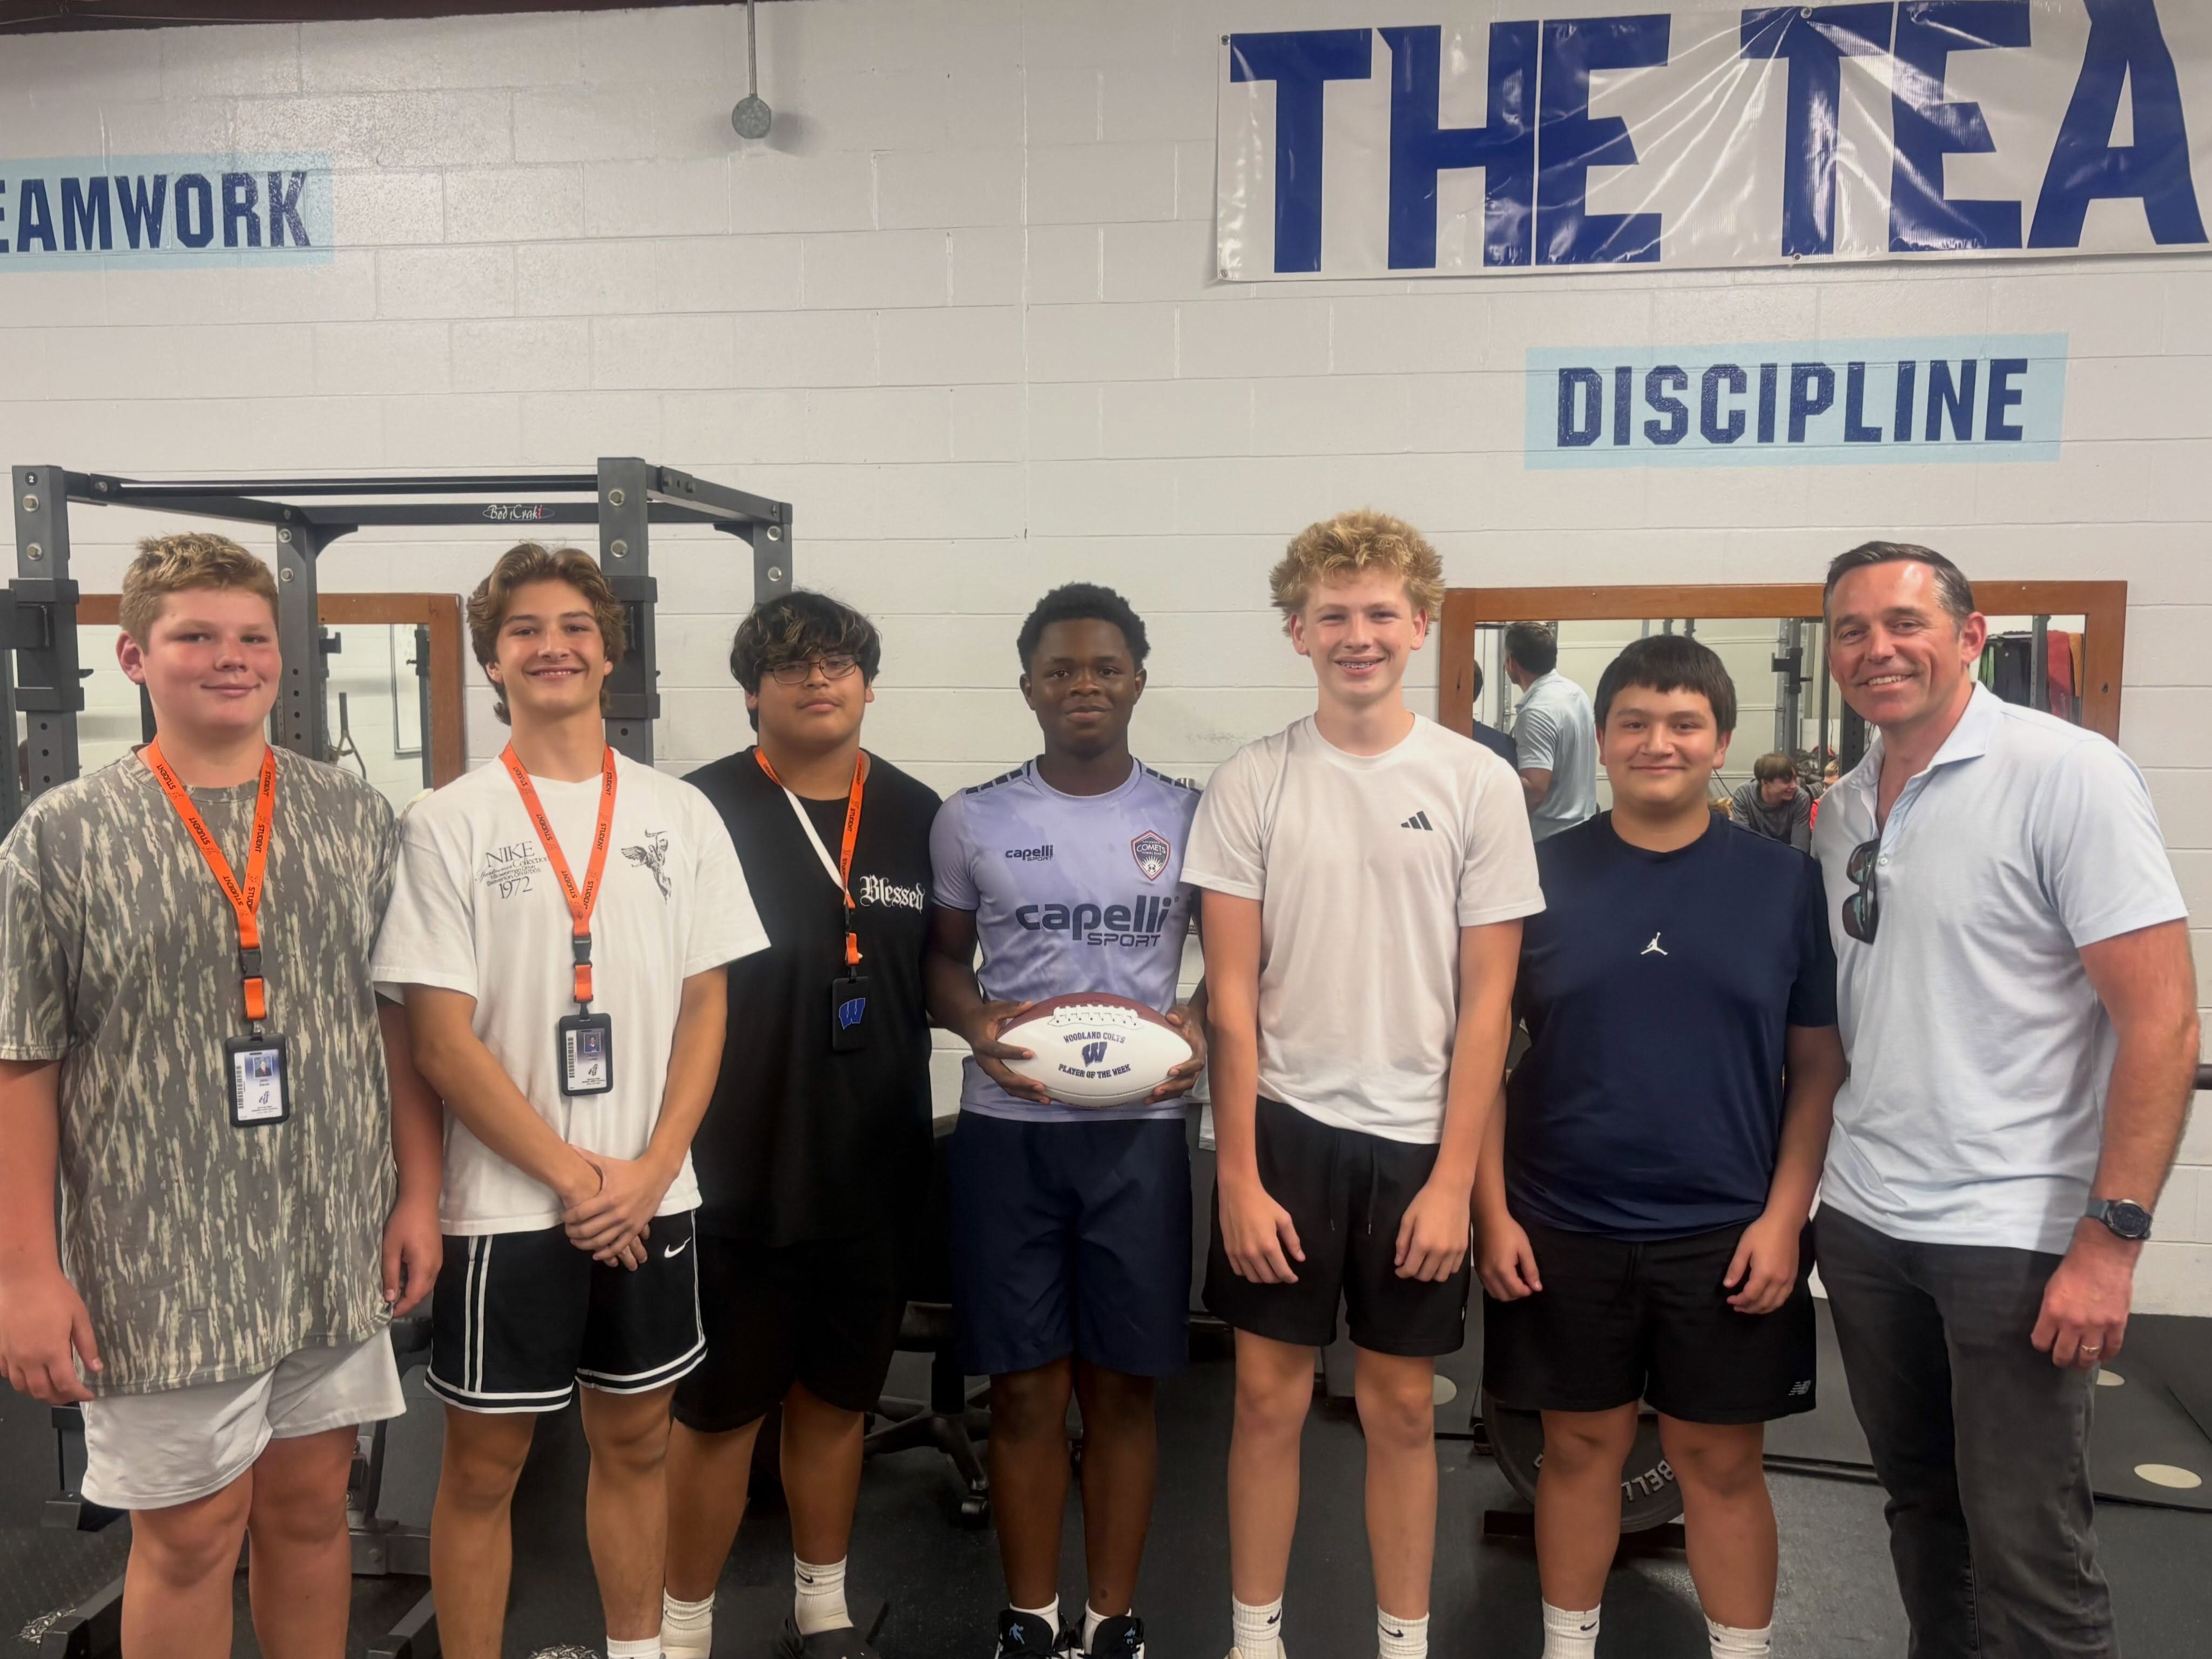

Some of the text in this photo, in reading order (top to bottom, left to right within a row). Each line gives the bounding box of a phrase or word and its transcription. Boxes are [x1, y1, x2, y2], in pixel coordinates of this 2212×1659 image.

[1230, 0, 2209, 273] THE TEA
[0, 171, 311, 253] AMWORK
[1557, 359, 2027, 447] DISCIPLINE
[157, 764, 176, 790] STUDENT
[514, 767, 528, 786] STUDENT
[189, 817, 211, 845] STUDENT
[536, 814, 552, 840] STUDENT
[847, 808, 855, 832] STUDENT
[255, 824, 264, 853] STUDENT
[597, 823, 606, 851] STUDENT
[1137, 844, 1166, 854] COMETS
[485, 841, 534, 867] NIKE
[1005, 845, 1053, 860] capelli
[223, 876, 244, 906] STUDENT
[499, 876, 532, 899] 1972
[562, 871, 577, 898] STUDENT
[860, 874, 926, 914] Blessed
[1015, 894, 1172, 940] capelli
[1087, 933, 1161, 947] SPORT
[839, 997, 866, 1030] W
[1063, 1031, 1126, 1043] WOODLAND COLTS
[1082, 1042, 1108, 1068] W
[1058, 1063, 1085, 1078] PLAYER
[1097, 1070, 1111, 1078] THE
[1112, 1064, 1131, 1076] WEEK
